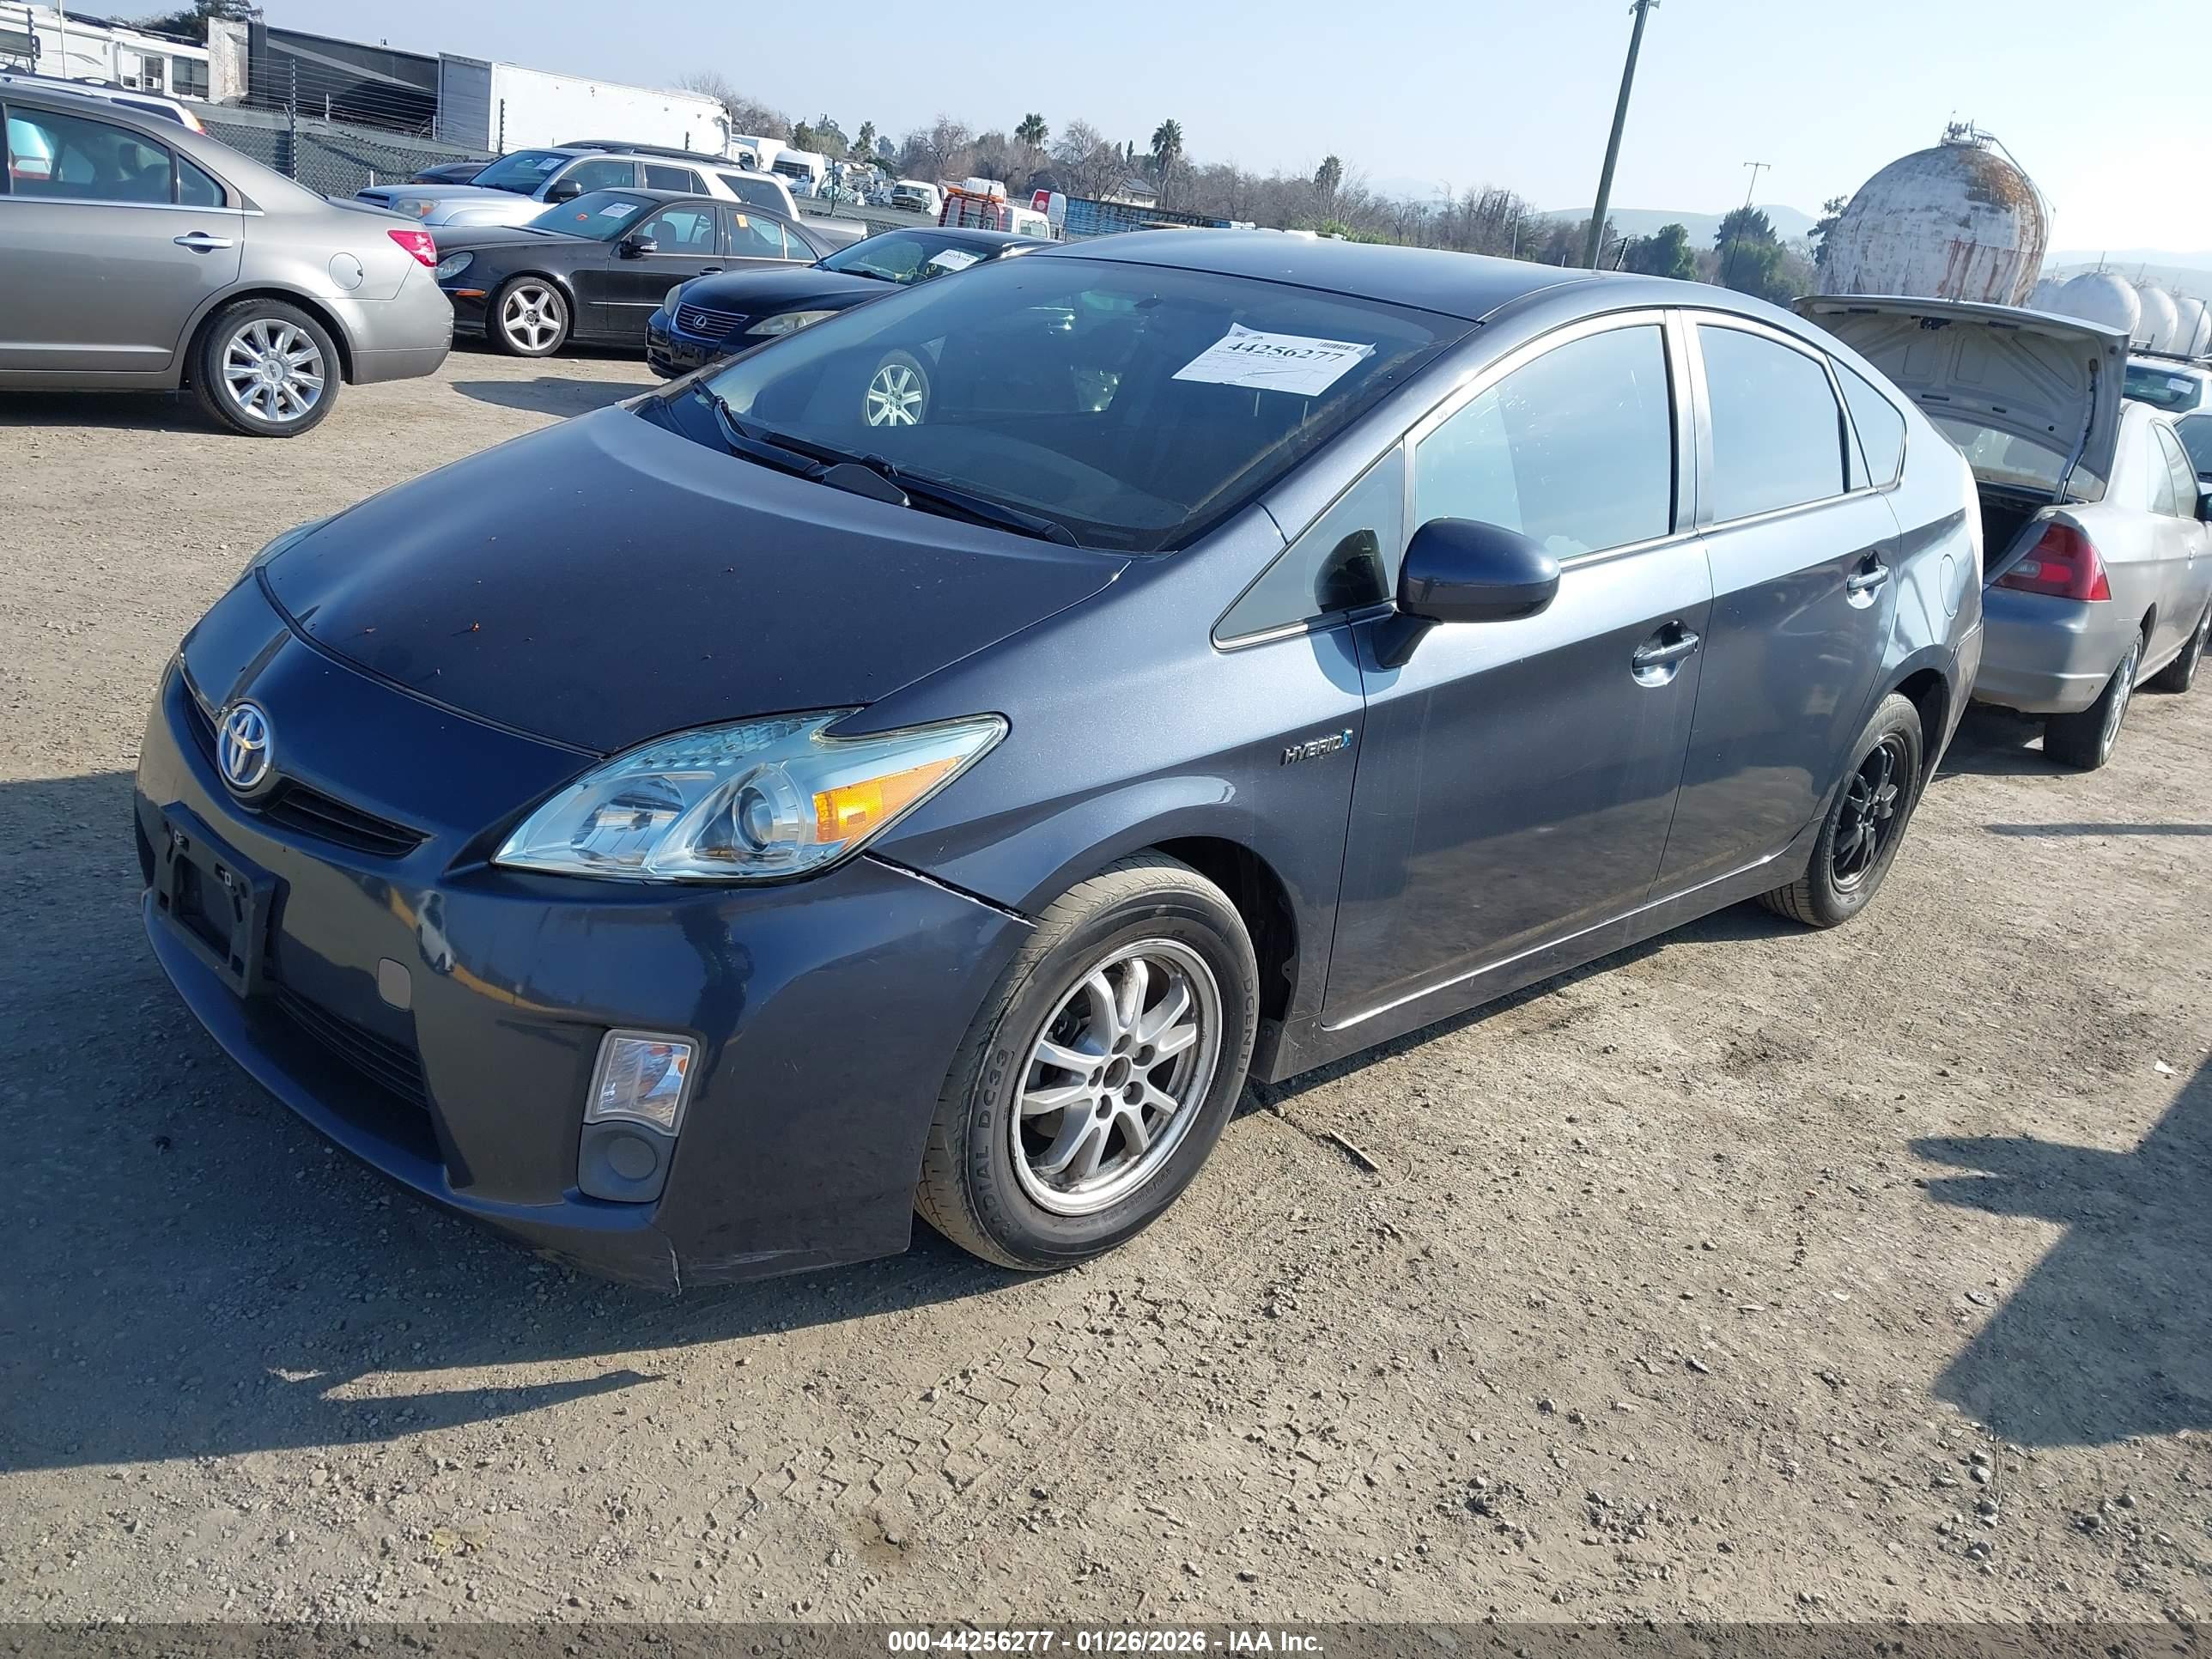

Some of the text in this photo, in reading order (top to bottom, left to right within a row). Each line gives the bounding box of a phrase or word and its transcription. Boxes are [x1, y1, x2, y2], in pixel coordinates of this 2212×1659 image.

[1228, 341, 1346, 362] 44256277
[1282, 735, 1342, 765] HYBRID
[978, 1048, 1009, 1128] DC33
